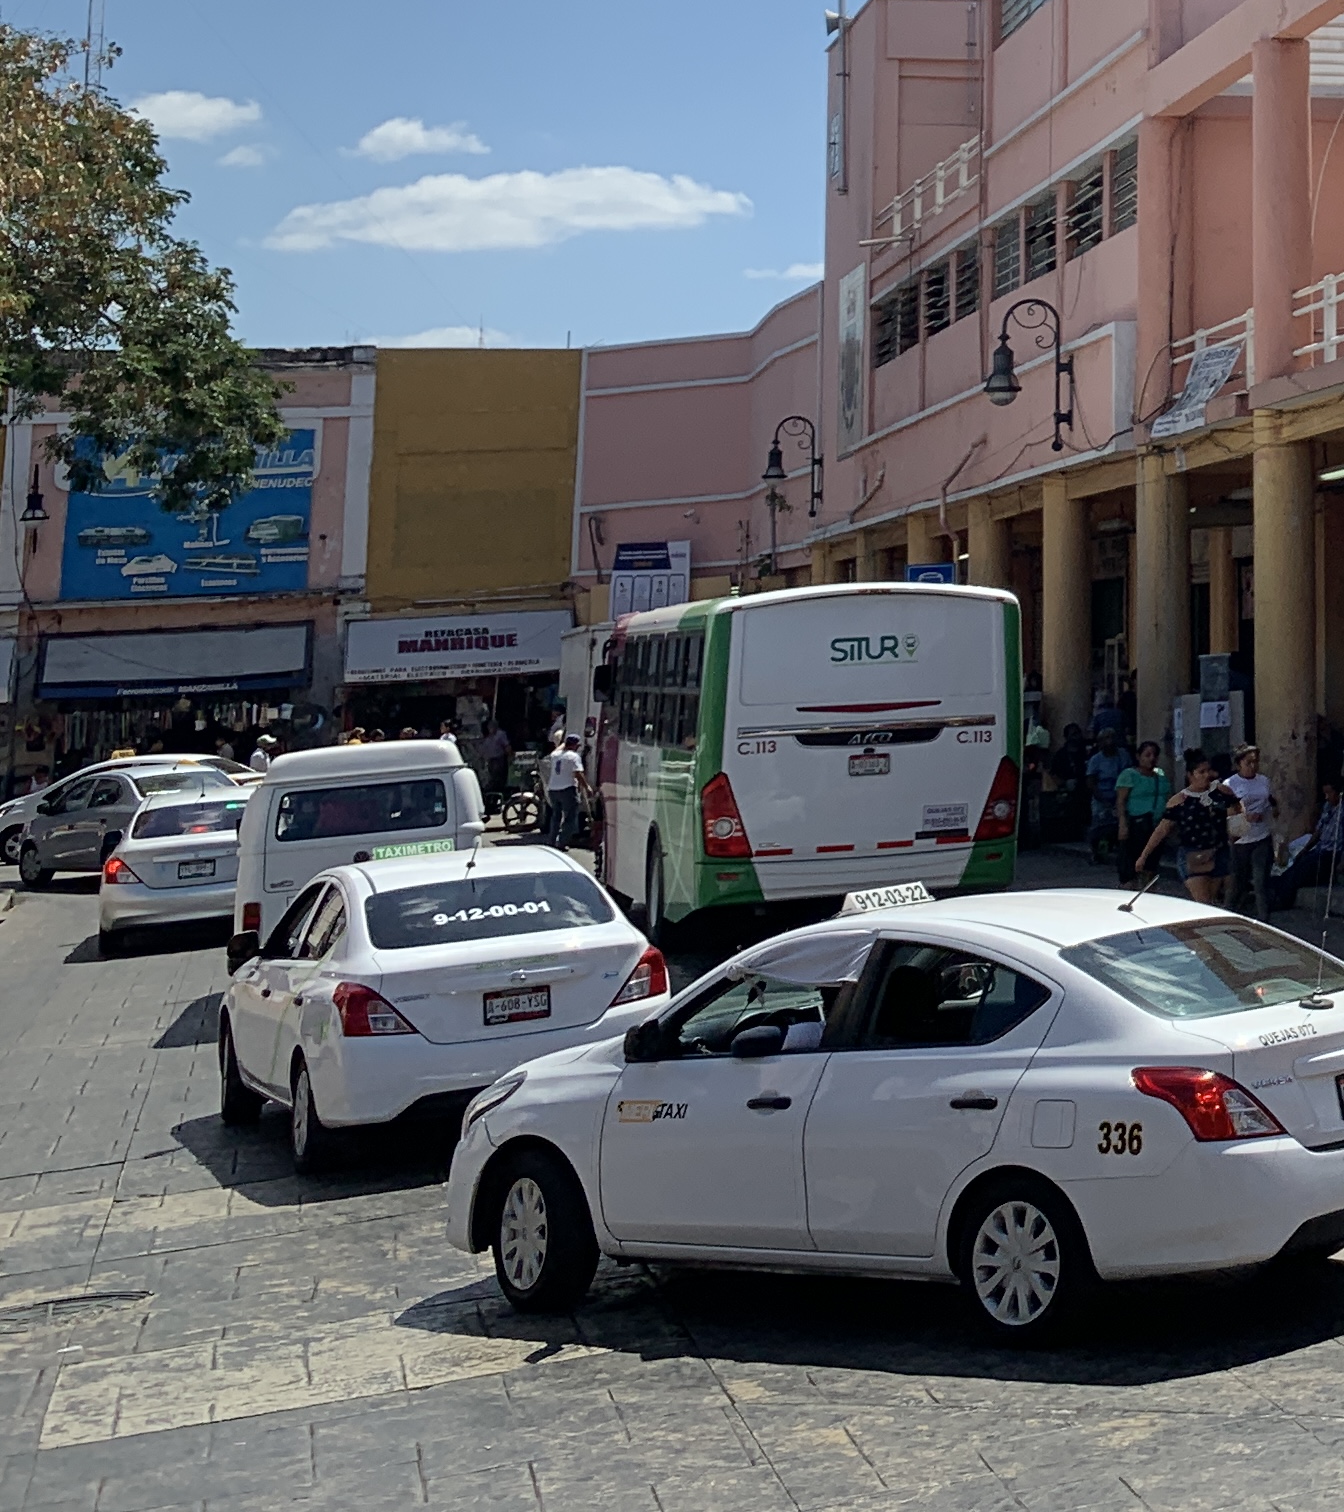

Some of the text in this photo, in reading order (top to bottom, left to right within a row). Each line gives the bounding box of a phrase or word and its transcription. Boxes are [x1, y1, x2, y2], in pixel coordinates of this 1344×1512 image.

[398, 633, 518, 654] MANRIQUE
[956, 730, 993, 744] C.113
[737, 740, 777, 756] C.113
[377, 839, 452, 858] TAXIMETRO
[855, 885, 928, 910] 912-03-22
[432, 900, 551, 926] 9-12-00-01
[1258, 1022, 1318, 1048] QUEJAS 072
[660, 1102, 689, 1119] TAXI
[1097, 1121, 1143, 1156] 336
